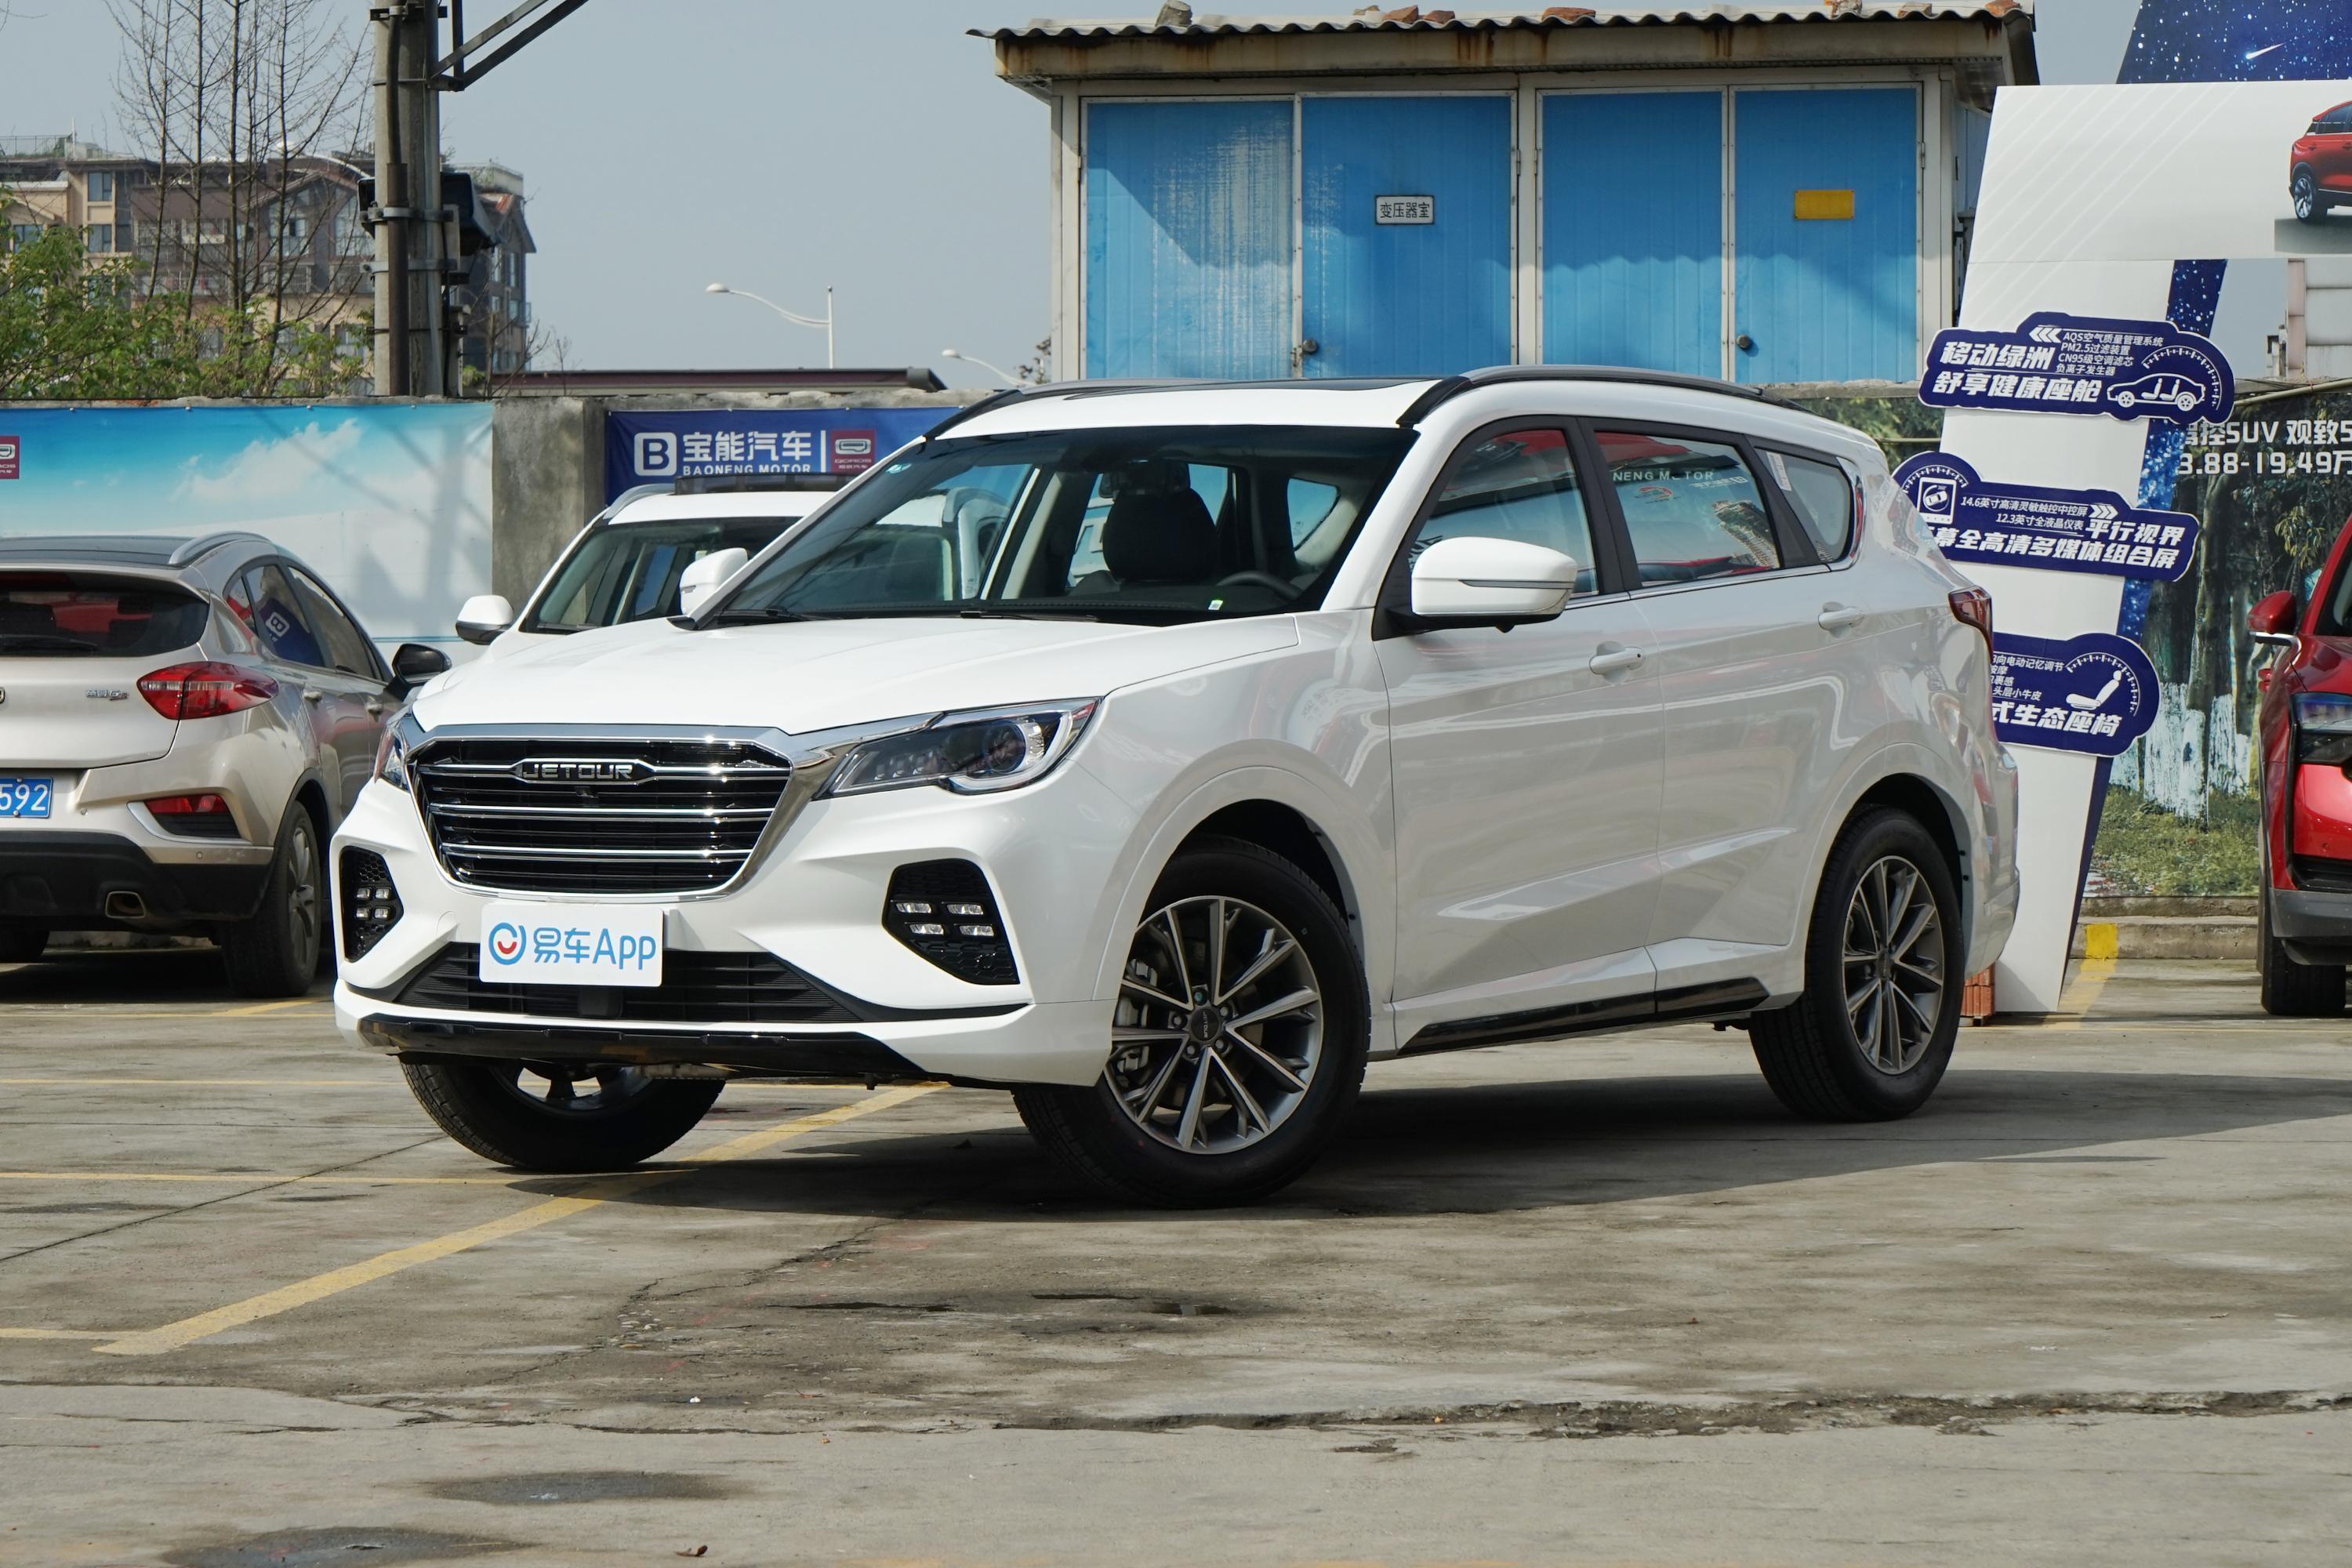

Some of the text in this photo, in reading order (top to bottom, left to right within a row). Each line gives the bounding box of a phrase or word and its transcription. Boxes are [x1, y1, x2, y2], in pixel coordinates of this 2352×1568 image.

[1380, 202, 1430, 219] 变压器室
[2063, 332, 2164, 347] AQS空气质量管理系统
[1940, 341, 2056, 370] 移动绿洲
[2060, 343, 2131, 356] PM2.5过滤装置
[2058, 353, 2134, 367] CN95级空调滤芯
[2055, 364, 2116, 376] 负离子发生器
[1932, 370, 2103, 403] 舒享健康座舱
[683, 430, 811, 462] 宝能汽车
[758, 463, 811, 473] MOTOR
[1659, 470, 1714, 481] MTOR
[1960, 496, 2088, 517] 14.6英寸高清灵敏触控中控屏
[1995, 513, 2084, 531] 12.3英寸全液晶仪表
[2085, 518, 2185, 546] 平行视界
[1929, 526, 2180, 569] 幕全高清多媒体组合屏
[1992, 685, 2042, 702] 头层小牛皮
[1991, 700, 2123, 737] 式生态座椅
[523, 764, 633, 779] JETOUR
[0, 783, 49, 811] 592
[533, 927, 657, 971] 易车App
